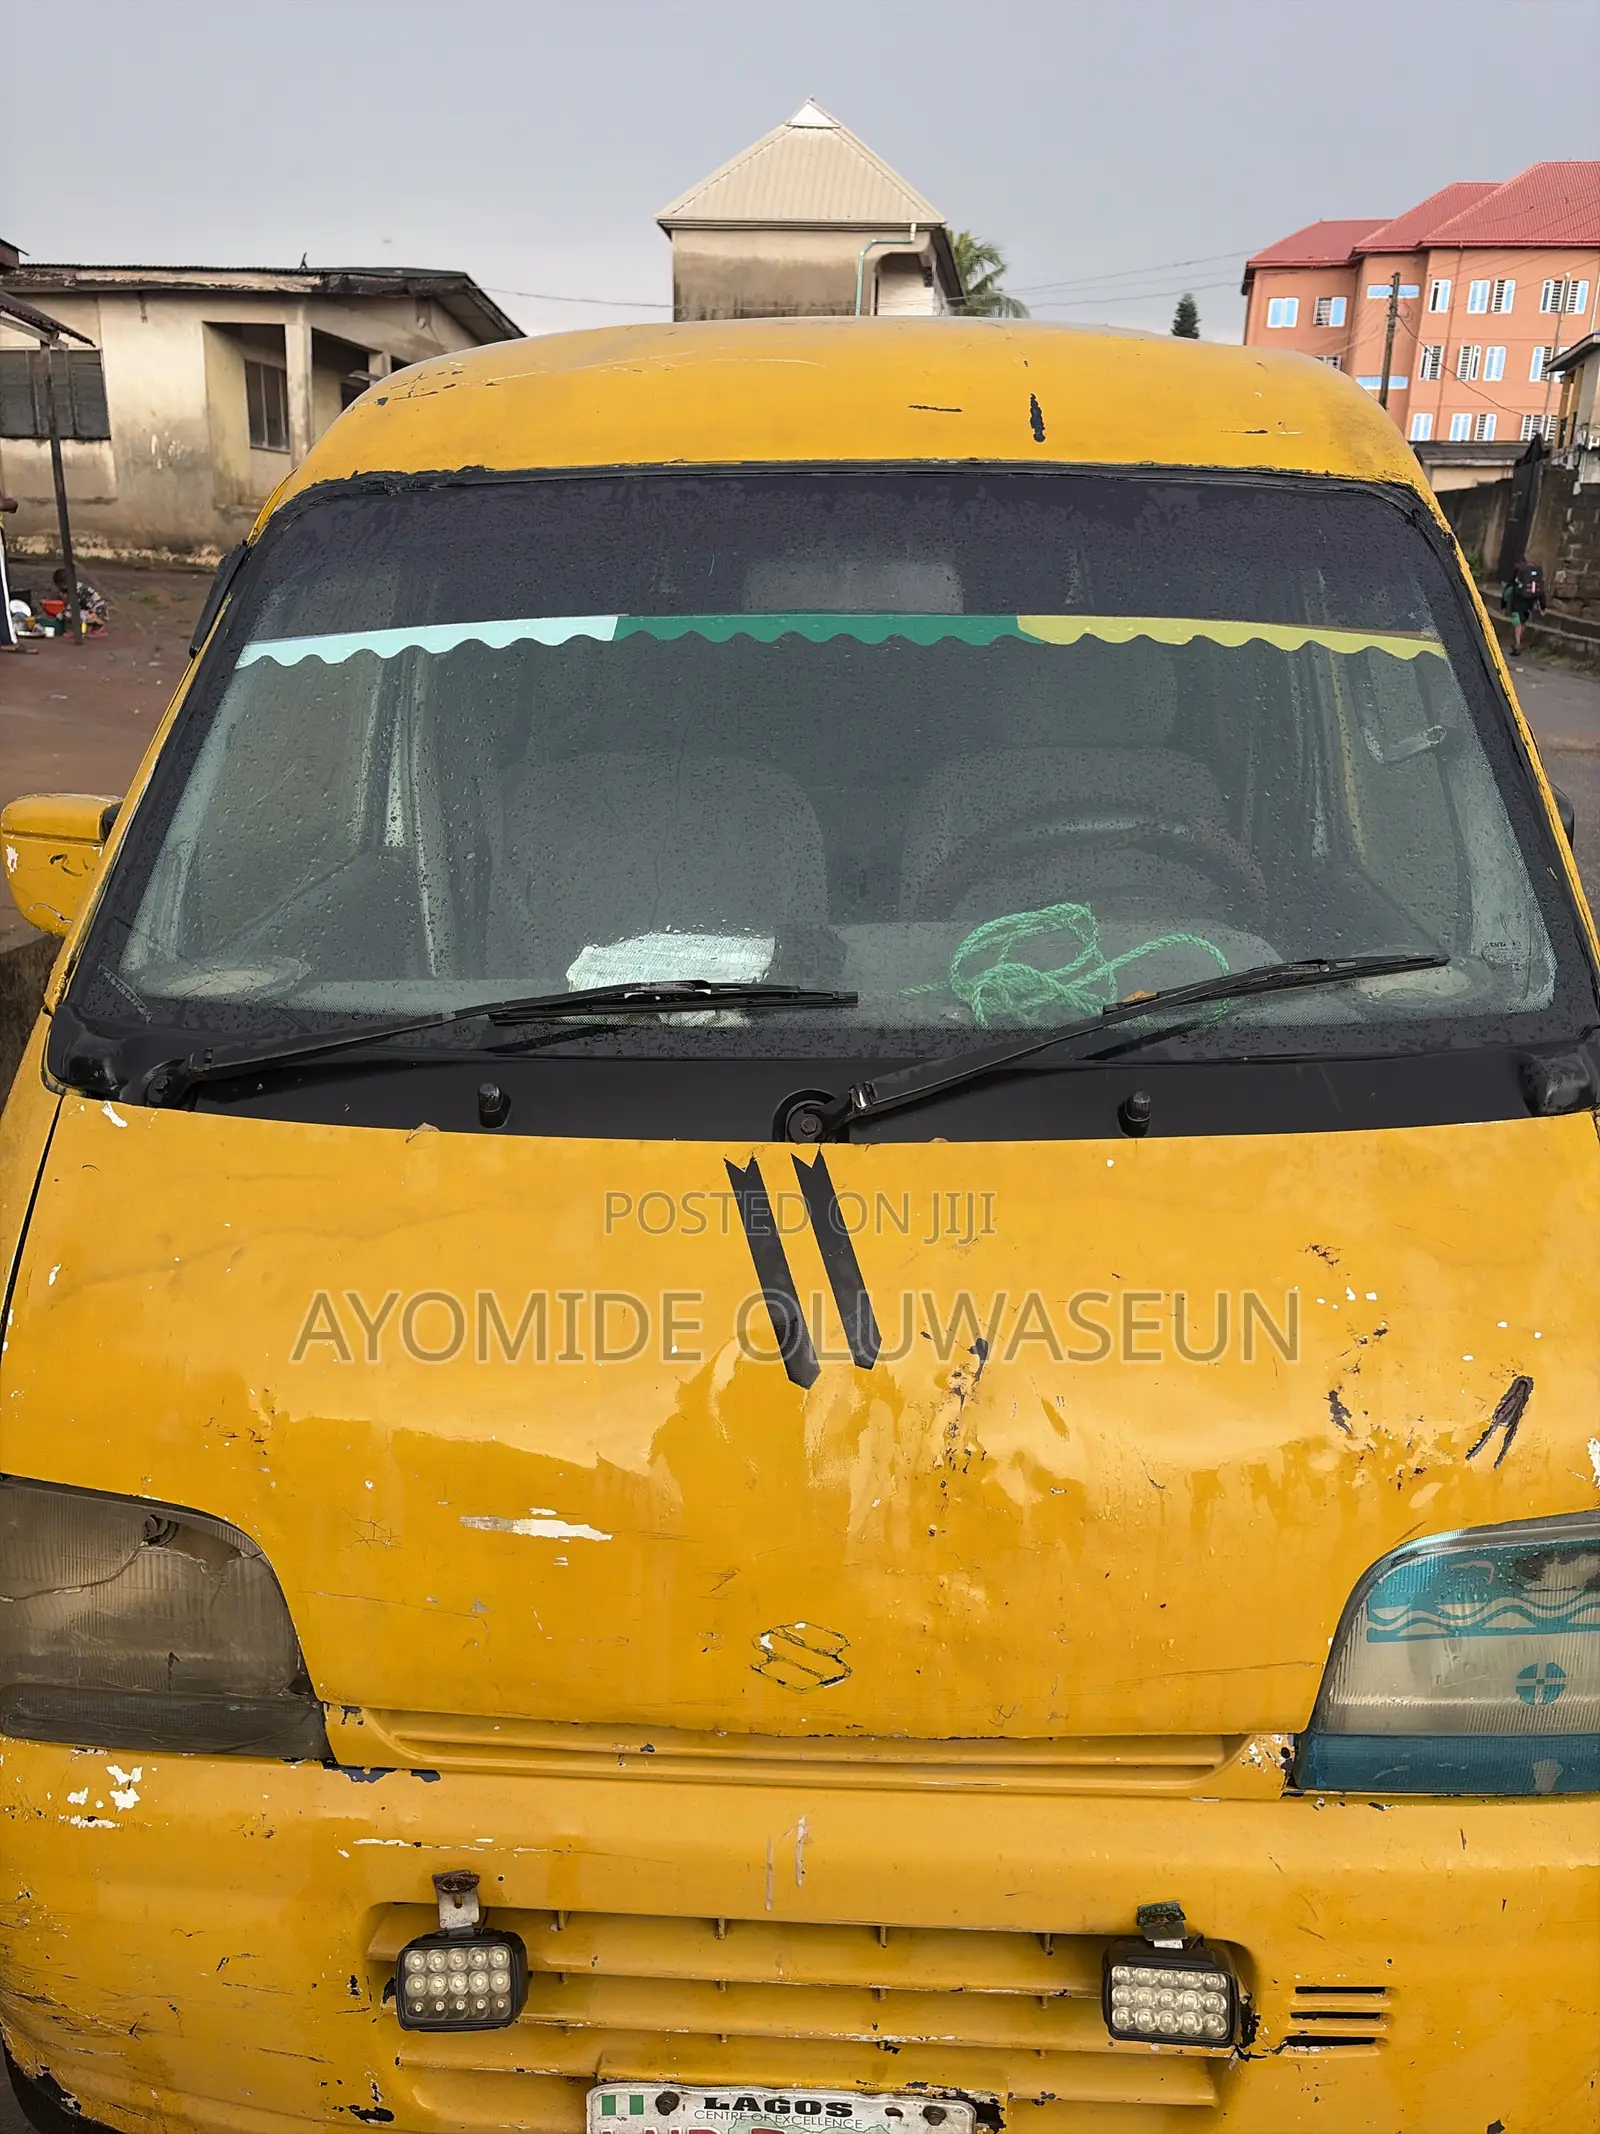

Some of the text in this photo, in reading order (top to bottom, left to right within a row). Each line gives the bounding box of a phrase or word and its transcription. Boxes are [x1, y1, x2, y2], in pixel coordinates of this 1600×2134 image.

[703, 2097, 853, 2118] LAGOS
[694, 2110, 863, 2129] CENTRE OF EXCELLENCE
